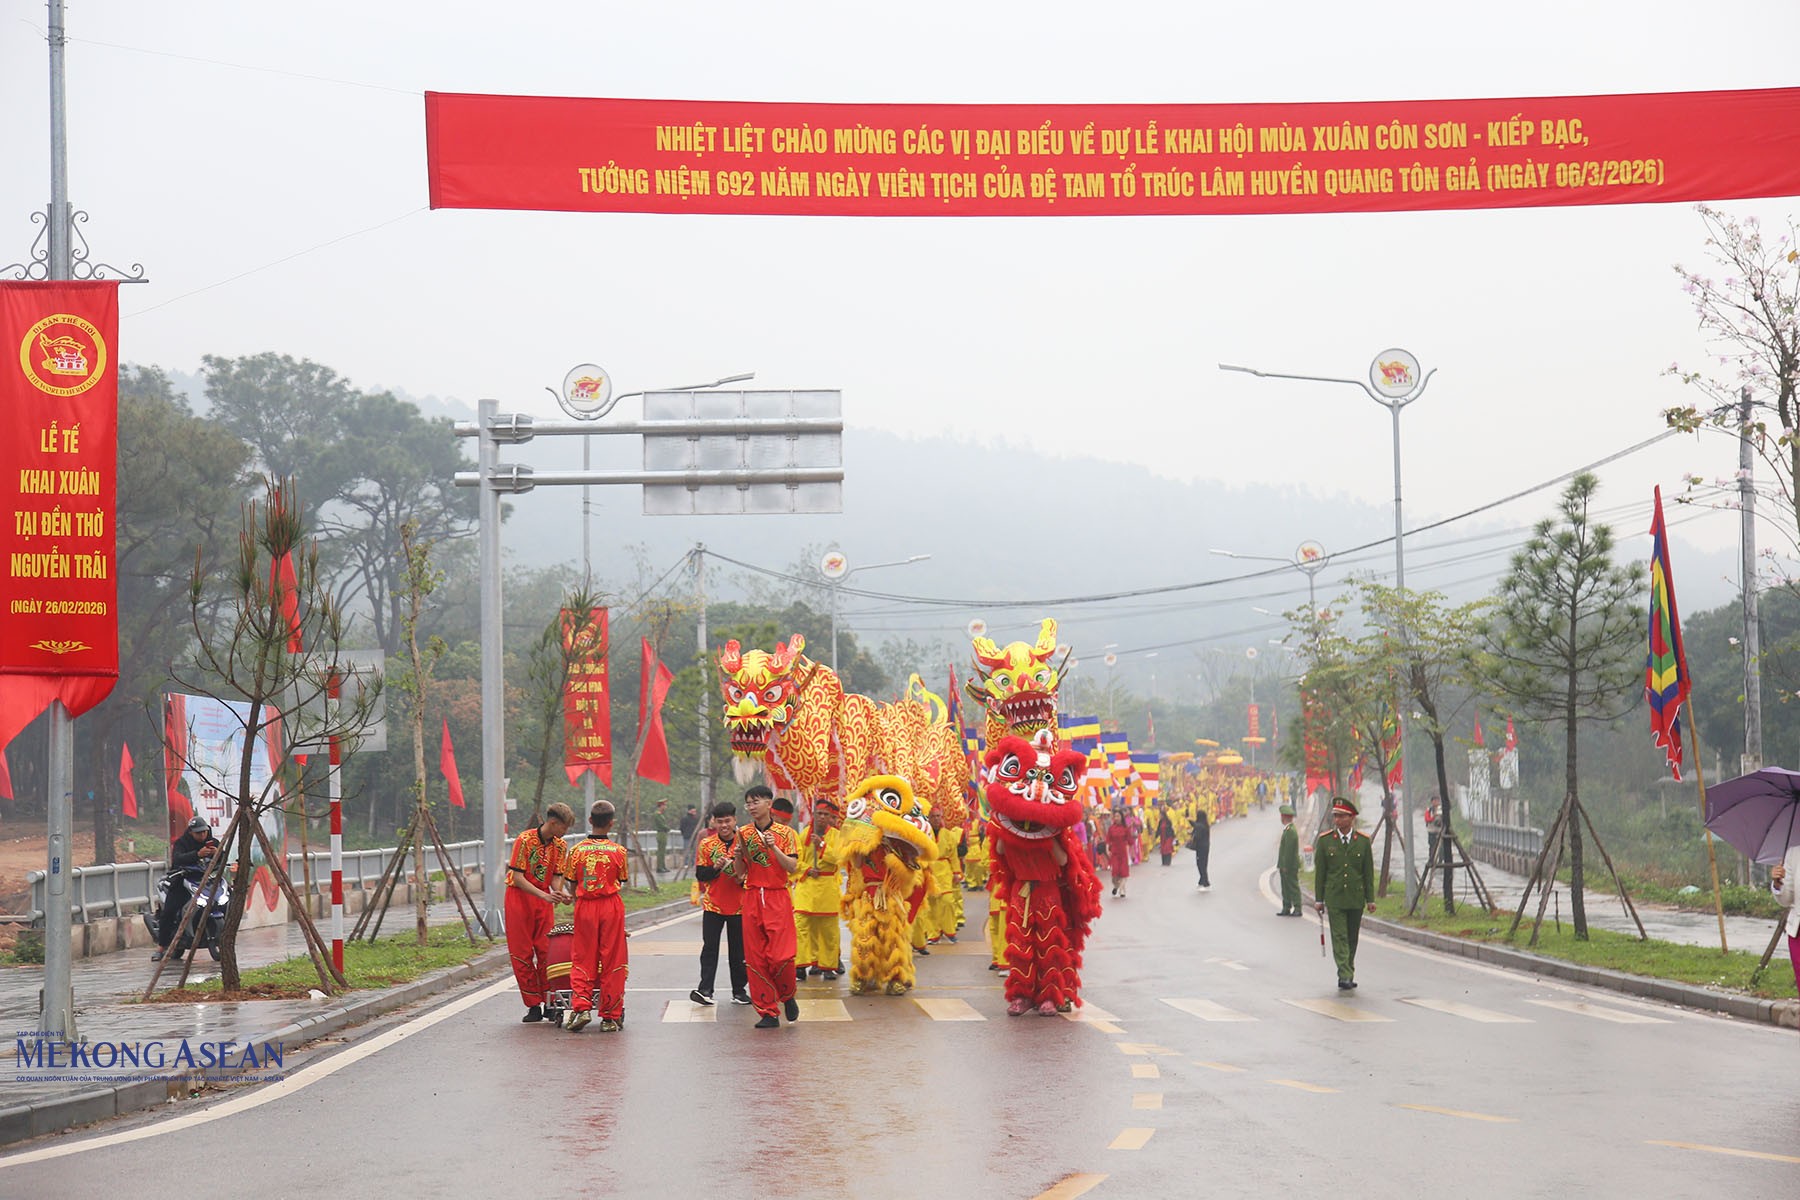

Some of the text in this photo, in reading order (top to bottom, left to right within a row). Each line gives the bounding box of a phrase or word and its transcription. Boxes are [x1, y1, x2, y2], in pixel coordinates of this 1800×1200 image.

[657, 121, 717, 157] NHIỆT
[724, 122, 765, 158] LIỆT
[772, 123, 827, 153] CHÀO
[834, 124, 896, 154] MỪNG
[903, 124, 944, 154] CÁC
[951, 130, 969, 160] VỊ
[976, 130, 1010, 160] ĐẠI
[1017, 120, 1064, 155] BIỂU
[1070, 122, 1095, 154] VỀ
[1102, 128, 1131, 160] DỰ
[1135, 120, 1158, 154] LỄ
[1165, 129, 1212, 153] KHAI
[1219, 123, 1253, 158] HỘI
[1260, 122, 1307, 152] MÙA
[1313, 121, 1369, 151] XUÂN
[1376, 120, 1418, 150] CÔN
[1425, 121, 1466, 148] SƠN
[1488, 113, 1534, 146] KIẾP
[1541, 119, 1589, 149] BẠC,
[578, 157, 1664, 203] TƯỞNG NIỆM 692 NĂM NGÀY VIÊN TỊCH CỦA ĐỆ TAM TỔ TRÚC LÂM HUYỀN QUANG TÔN GIẢ (NGÀY 06/3/2026)
[40, 384, 65, 395] WORLD
[66, 376, 98, 395] HERITAGE
[41, 420, 80, 453] LỄ TẾ
[20, 466, 100, 495] KHAI XUÂN
[15, 504, 104, 541] TẠI ĐỀN THỜ
[11, 545, 107, 579] NGUYỄN TRÃI
[10, 598, 107, 615] (NGÀY 26/02/2026)
